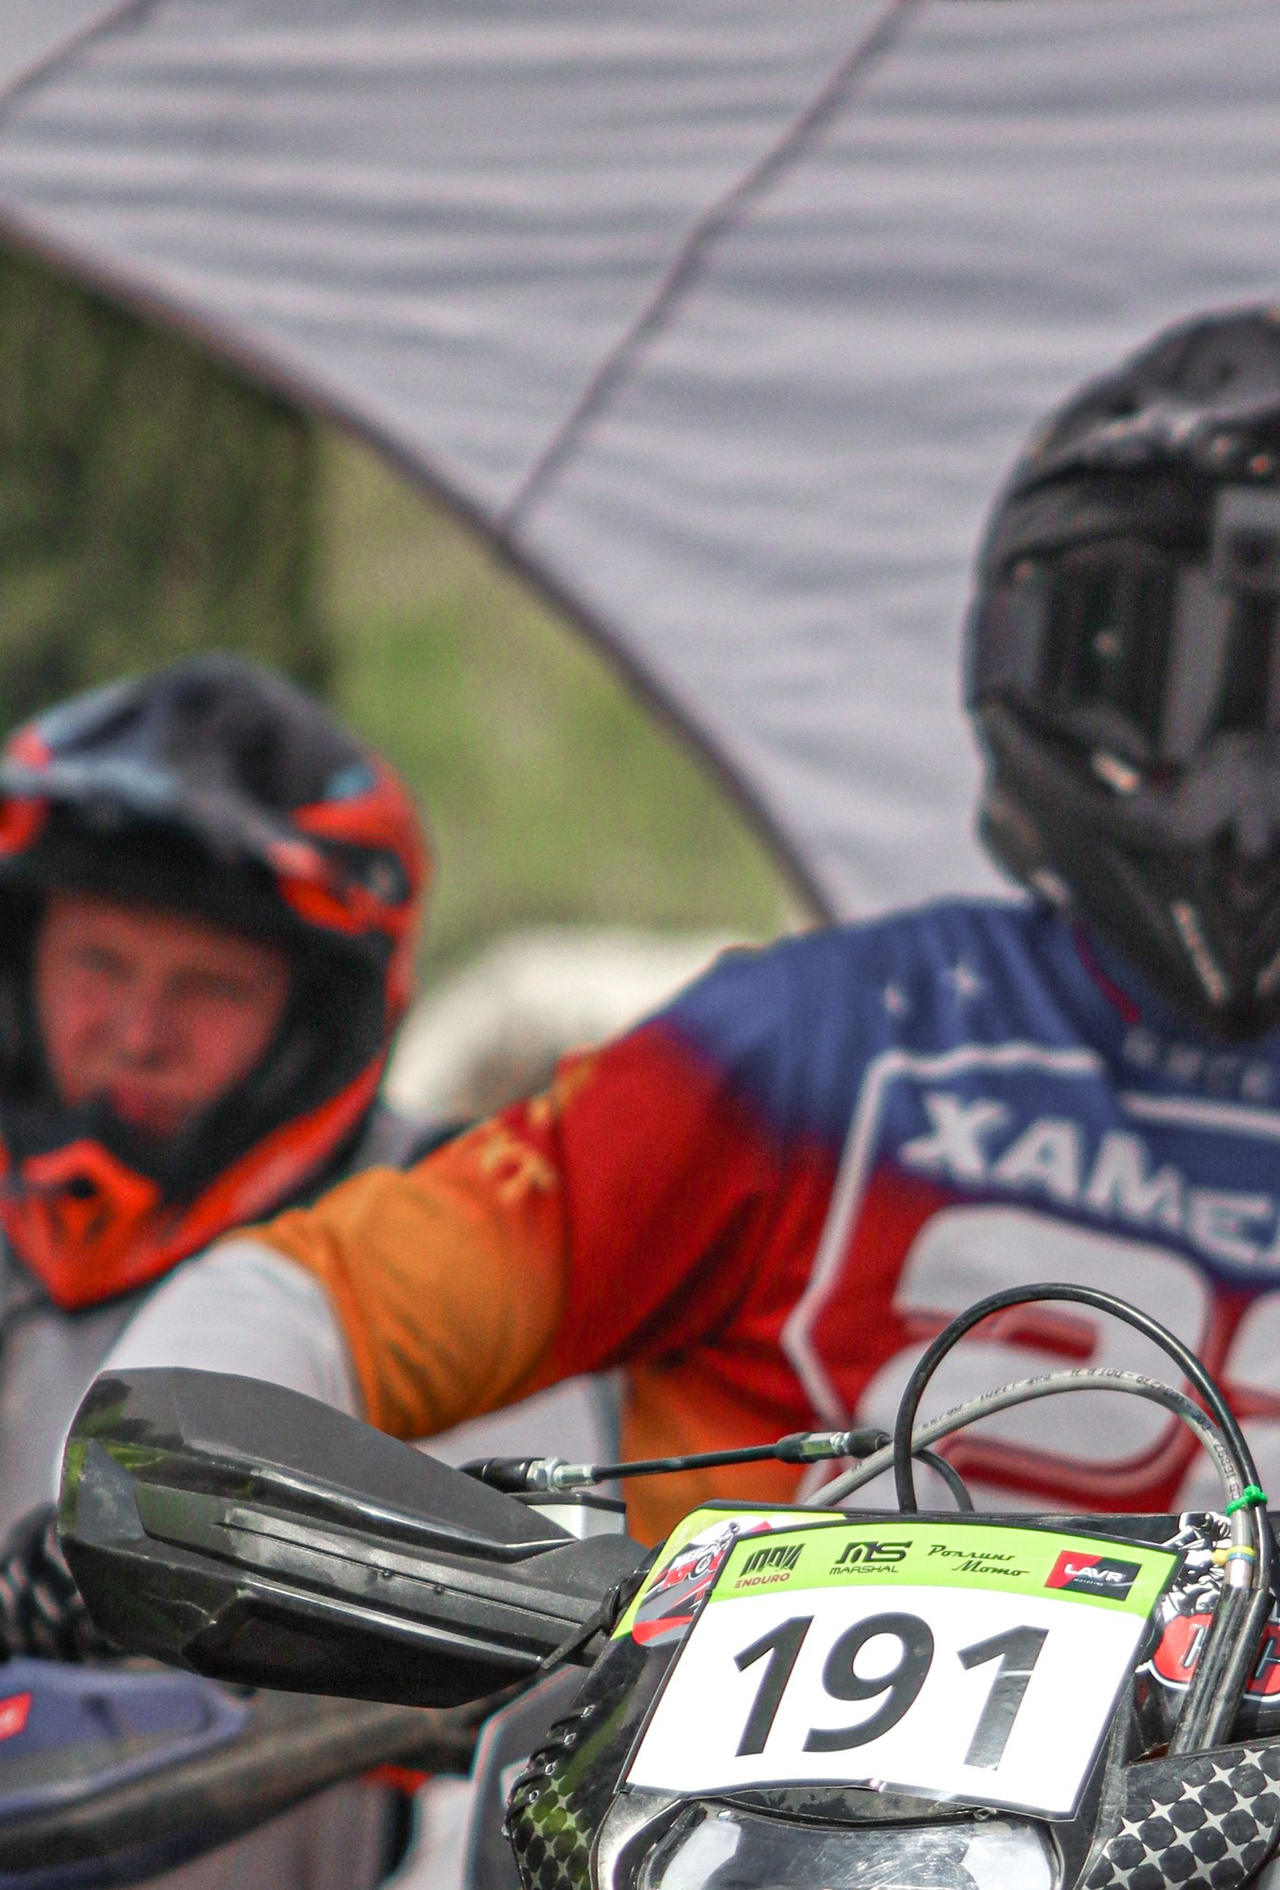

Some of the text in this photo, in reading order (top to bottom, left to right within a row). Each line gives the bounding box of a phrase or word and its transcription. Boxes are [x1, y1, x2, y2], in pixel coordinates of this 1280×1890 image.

[829, 1565, 898, 1575] MARSHAL
[1064, 1563, 1124, 1582] LAVR
[734, 1572, 791, 1589] ENDURO
[733, 1611, 1050, 1772] 191
